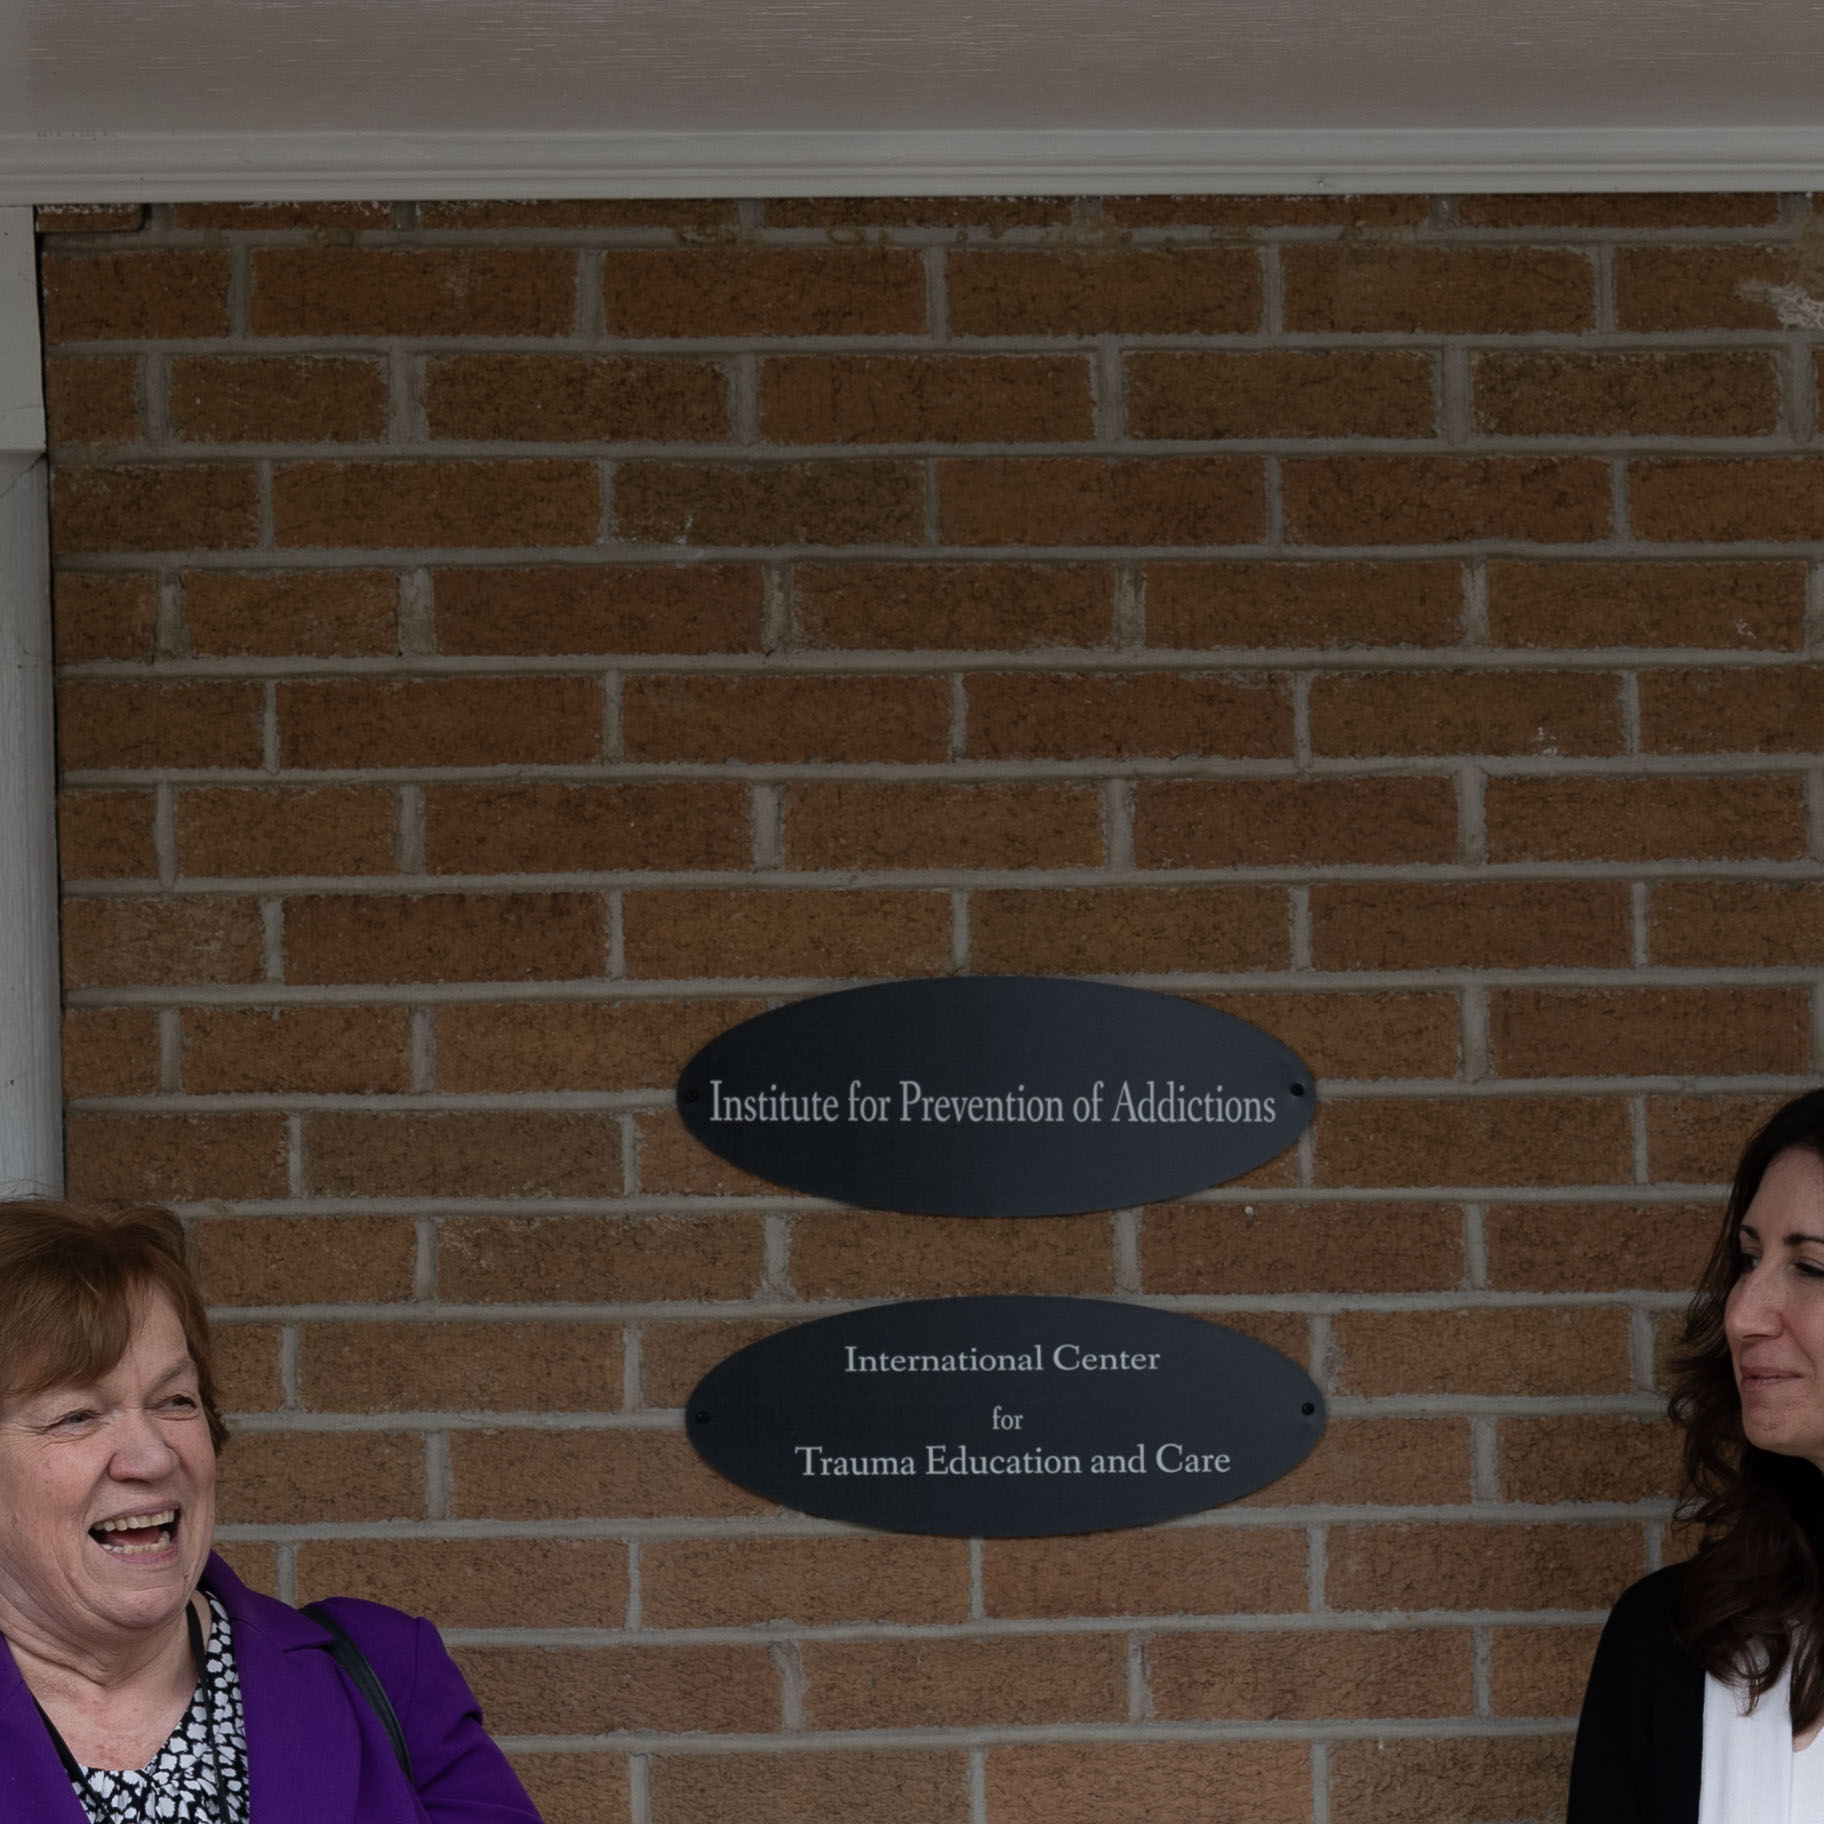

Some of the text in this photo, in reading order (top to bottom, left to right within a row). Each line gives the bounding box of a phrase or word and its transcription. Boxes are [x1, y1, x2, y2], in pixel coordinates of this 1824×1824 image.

[711, 1080, 1276, 1123] Institute for Prevention of Addictions
[846, 1344, 1161, 1372] International Center
[993, 1406, 1024, 1431] for
[795, 1443, 1231, 1476] Trauma Education and Care
